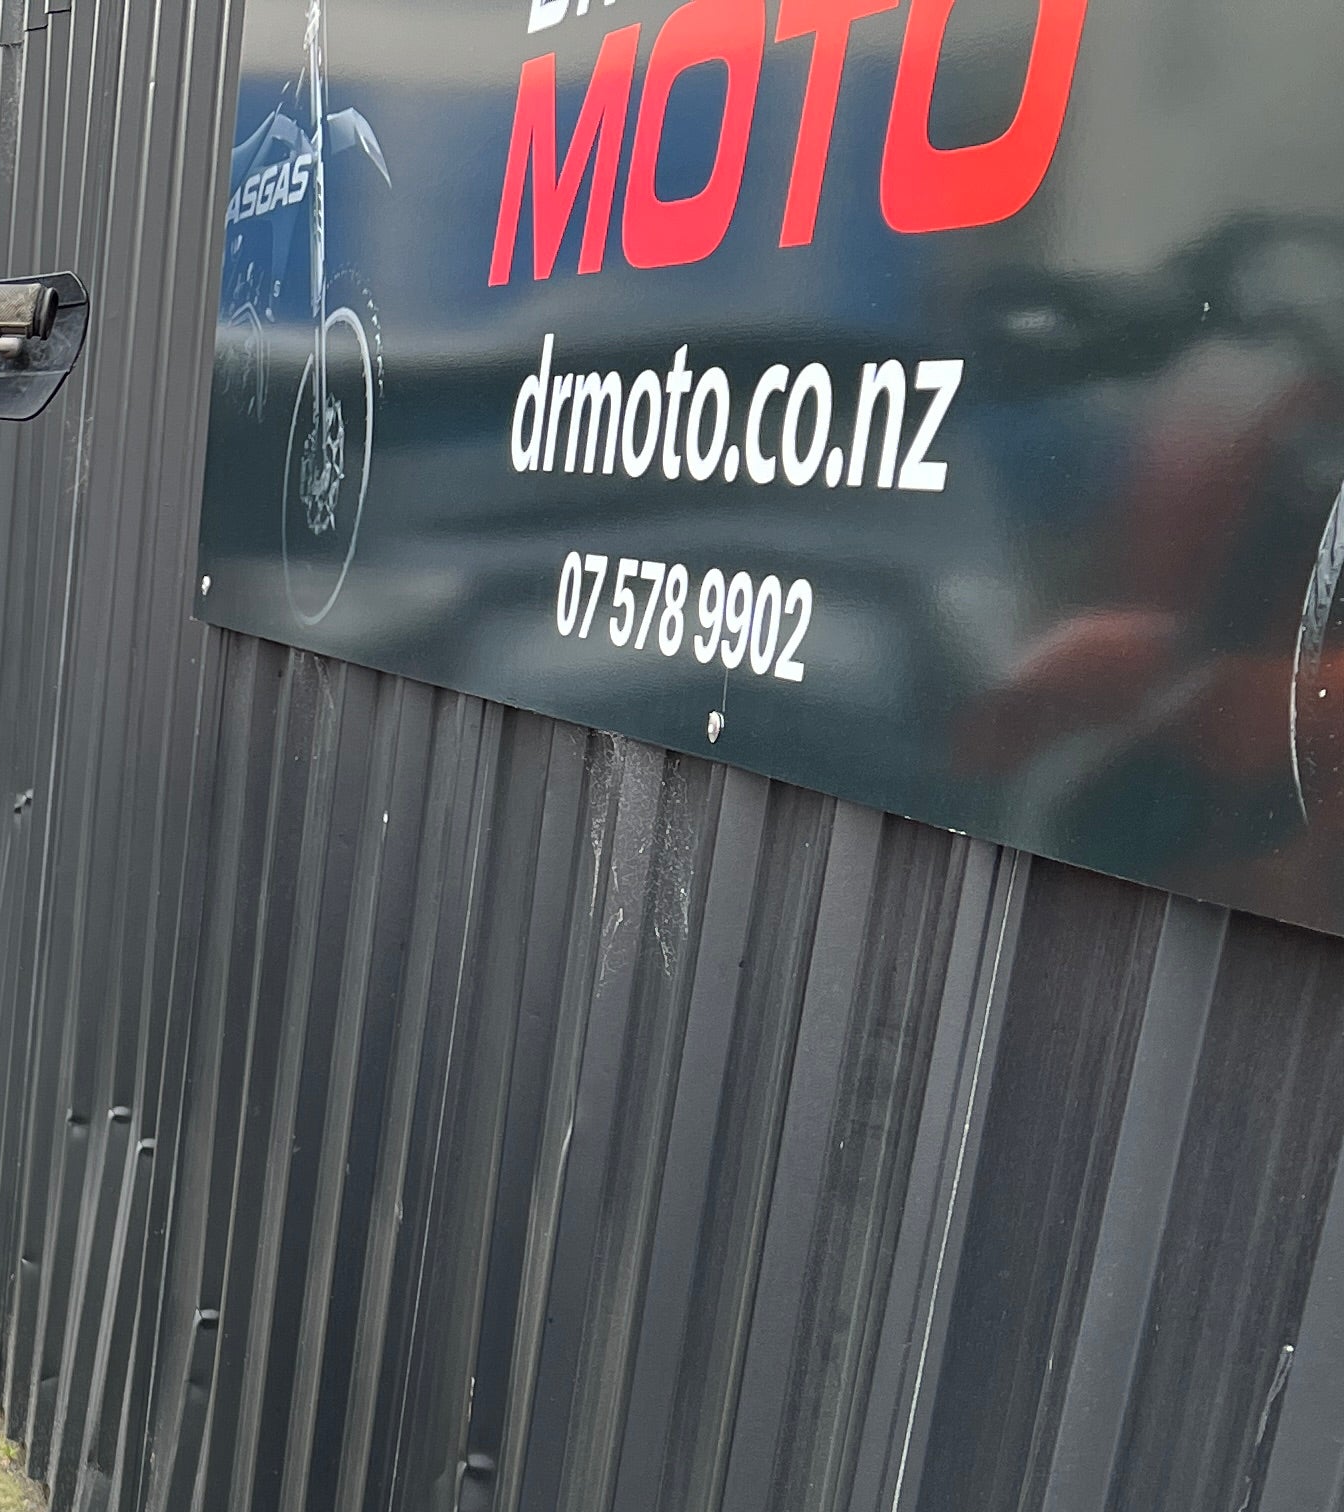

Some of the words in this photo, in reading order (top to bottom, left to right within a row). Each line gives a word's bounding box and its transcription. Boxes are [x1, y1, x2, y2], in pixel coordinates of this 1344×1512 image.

[489, 0, 1087, 286] MOTO
[512, 333, 964, 491] drmoto.co.nz
[556, 551, 608, 639] 07
[609, 558, 688, 656] 578
[694, 568, 812, 683] 9902
